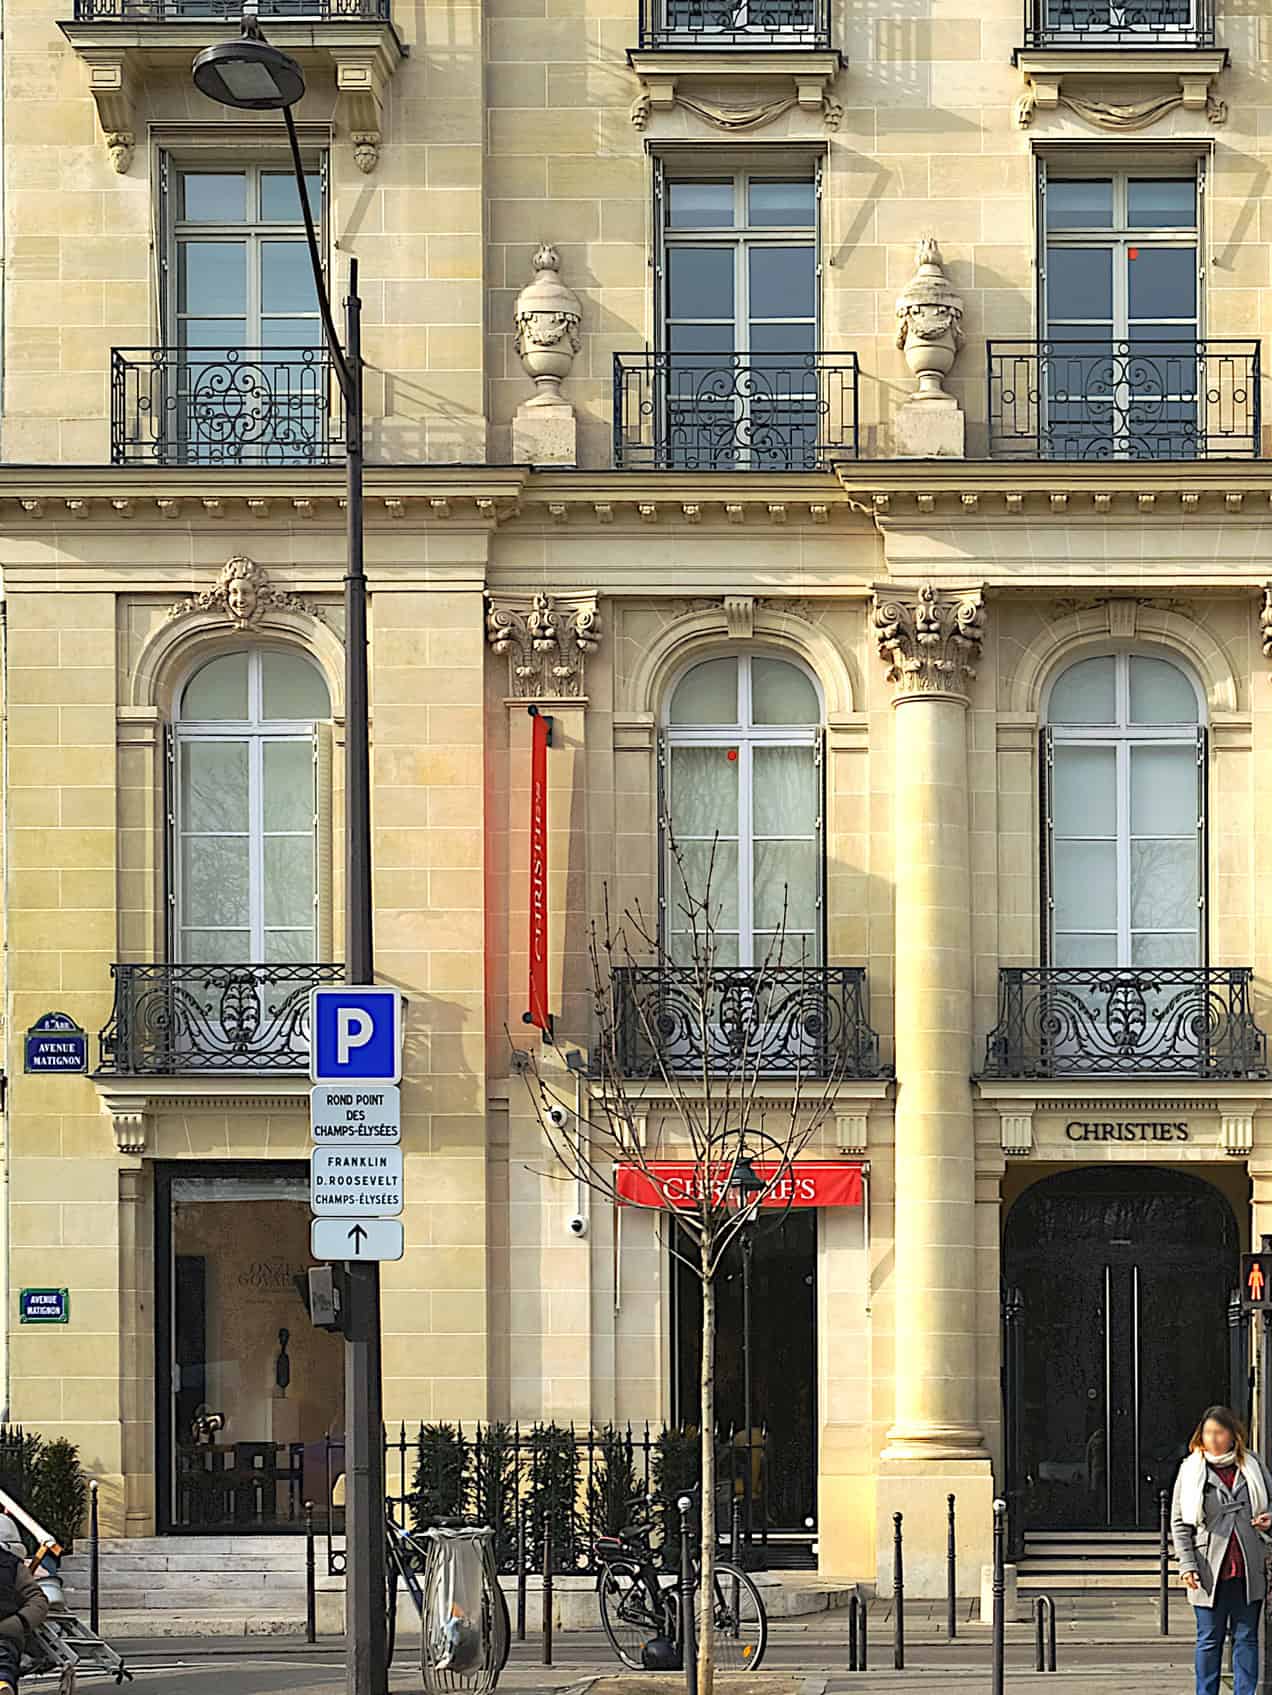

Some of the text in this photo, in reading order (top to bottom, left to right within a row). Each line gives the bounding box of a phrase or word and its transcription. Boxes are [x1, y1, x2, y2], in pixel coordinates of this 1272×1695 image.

[337, 1007, 374, 1064] P
[39, 1043, 76, 1053] AVENUE
[33, 1056, 81, 1065] MATIGNON
[326, 1094, 384, 1105] ROND POINT
[346, 1110, 366, 1121] DES
[314, 1123, 398, 1136] CHAMPS-ÉLYSÉES
[1065, 1121, 1189, 1141] CHRISTIE'S
[328, 1157, 387, 1167] FRANKLIN
[315, 1193, 399, 1205] CHAMPS-ÉLYSÉES
[31, 1295, 57, 1304] AVENUE
